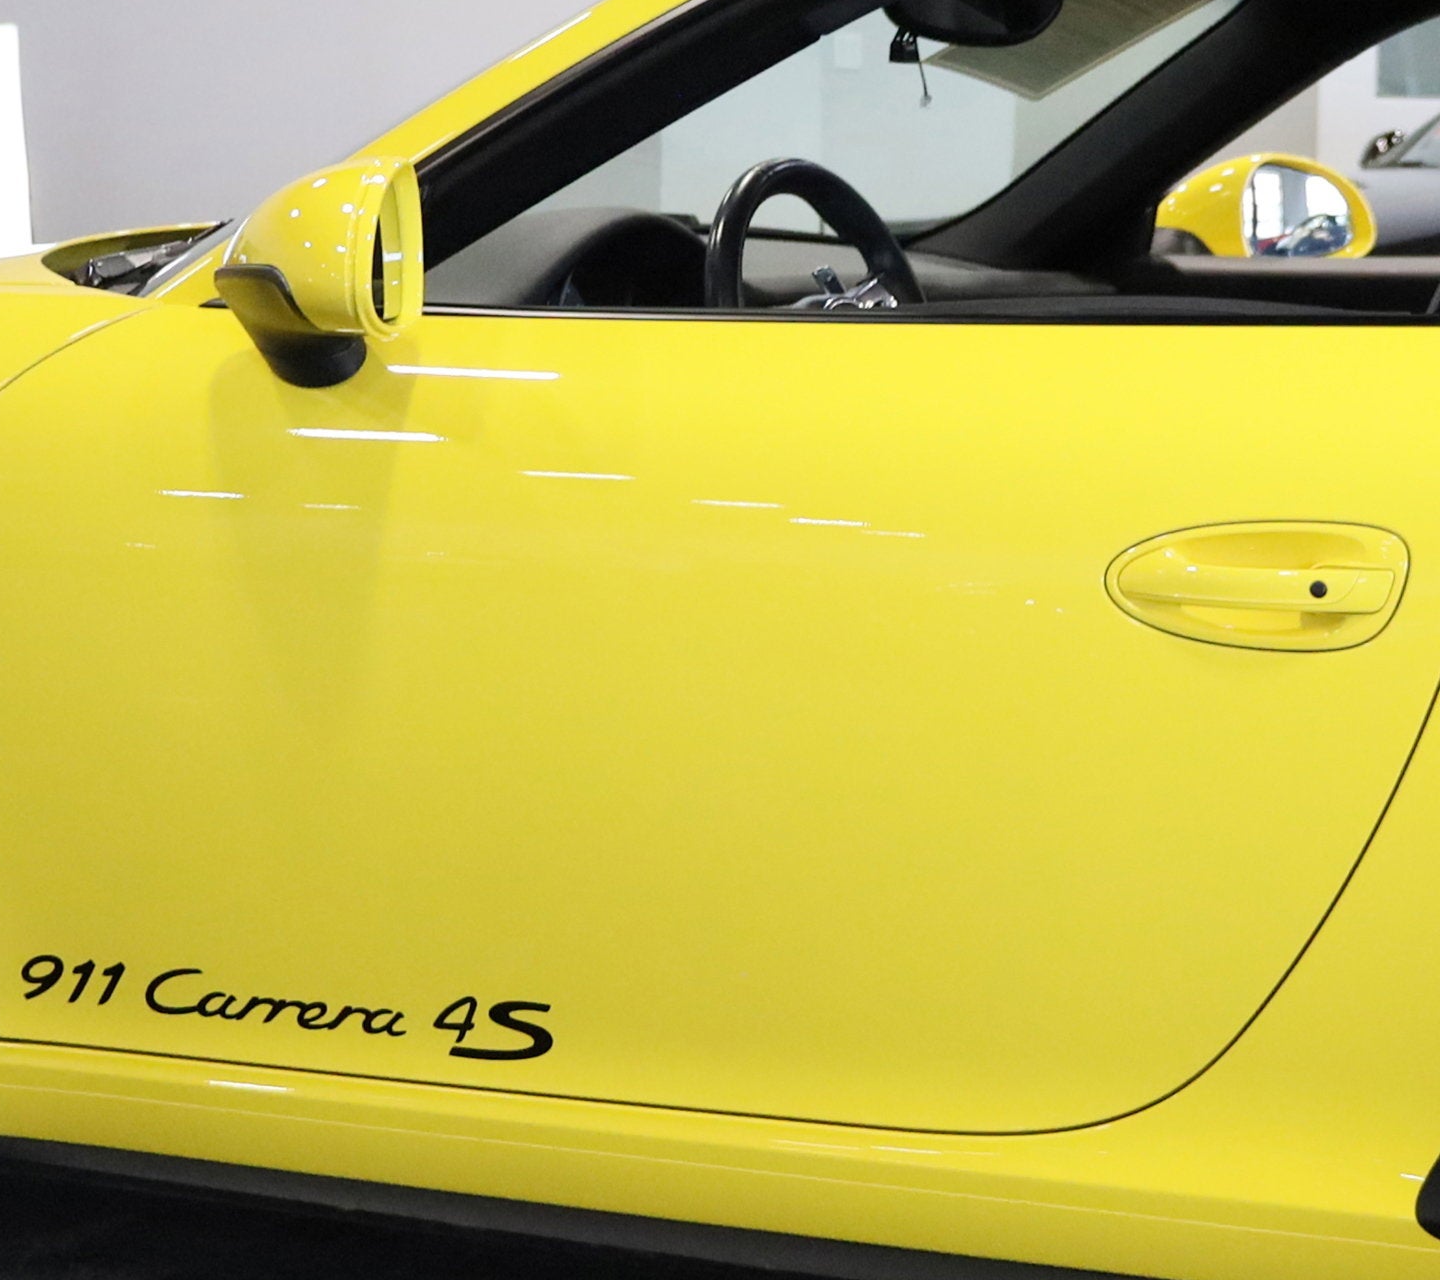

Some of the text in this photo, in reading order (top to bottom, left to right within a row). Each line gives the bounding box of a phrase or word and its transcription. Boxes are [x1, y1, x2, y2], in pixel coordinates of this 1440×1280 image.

[21, 955, 553, 1061] 911 Carrera 4S
